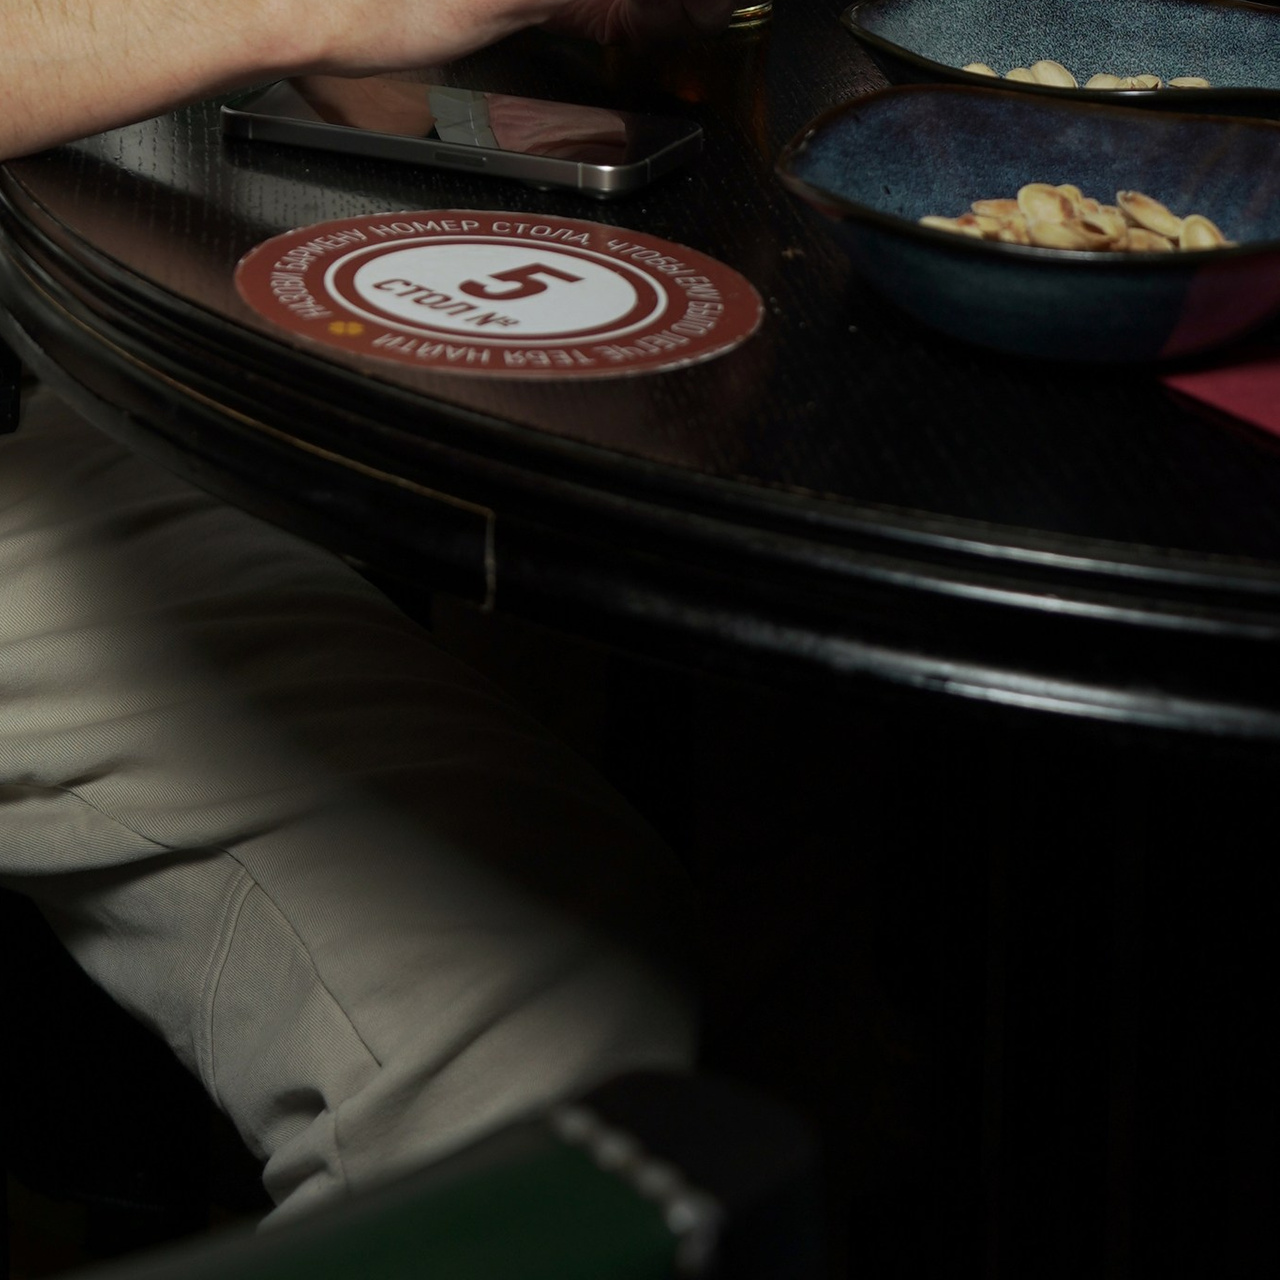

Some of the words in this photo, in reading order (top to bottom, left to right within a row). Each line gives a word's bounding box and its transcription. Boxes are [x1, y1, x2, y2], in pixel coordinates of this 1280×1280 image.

[368, 220, 480, 238] НОМЕР
[492, 221, 591, 246] СТОЛА,
[274, 228, 367, 272] БАРМЕНУ
[607, 239, 695, 276] ЧТОБЫ
[270, 272, 333, 320] НАЗОВИ
[373, 278, 479, 316] СТОЛ
[459, 262, 586, 300] 5
[674, 276, 723, 301] ЕМУ
[670, 301, 724, 337] БЫЛО
[372, 332, 492, 365] НАЙТИ
[503, 348, 596, 367] ТЕБЯ
[591, 329, 691, 362] ЛЕГЧЕ
